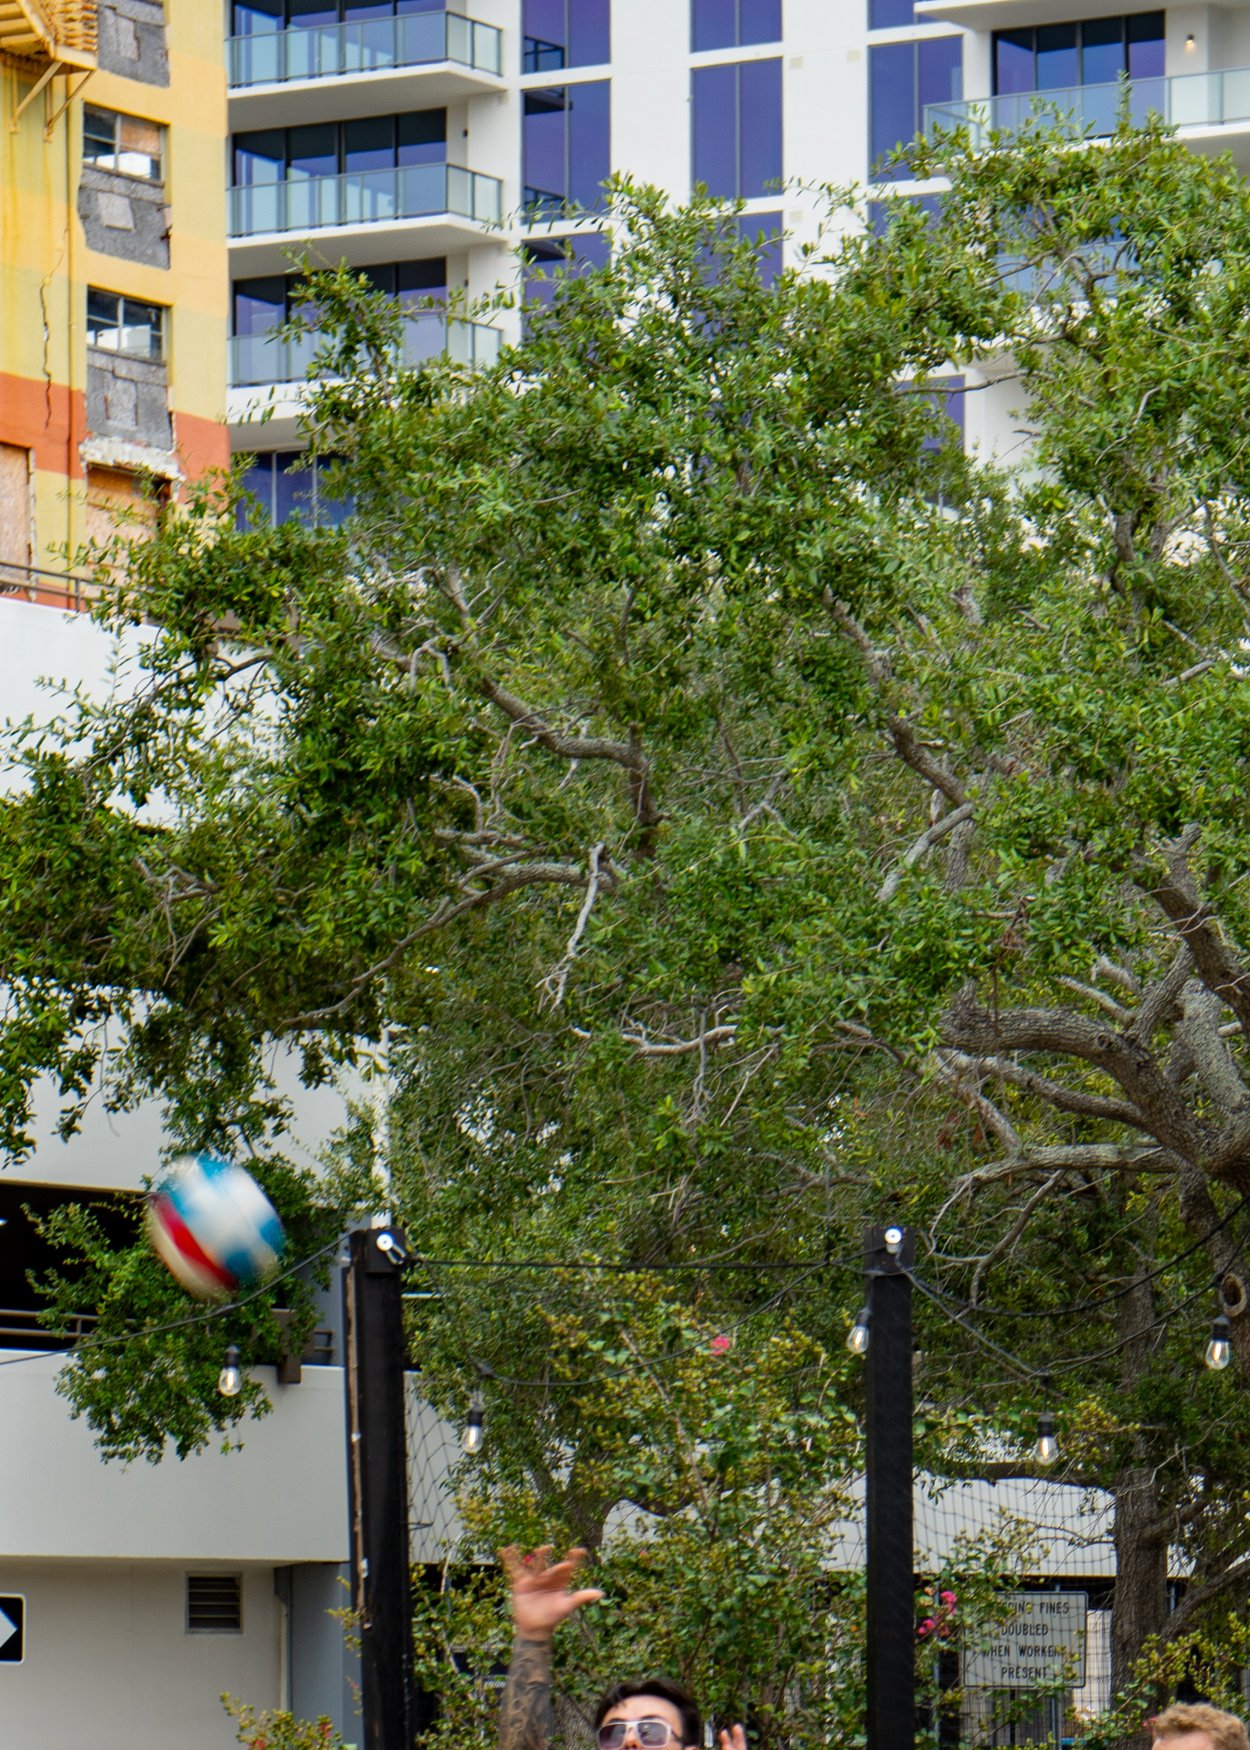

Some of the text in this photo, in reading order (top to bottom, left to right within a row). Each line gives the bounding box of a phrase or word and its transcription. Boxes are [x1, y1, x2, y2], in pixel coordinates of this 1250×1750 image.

[1039, 1601, 1070, 1615] FINES
[1001, 1623, 1049, 1636] DOUBLED
[1019, 1644, 1065, 1658] WORKE
[1001, 1666, 1048, 1679] PRESENT
